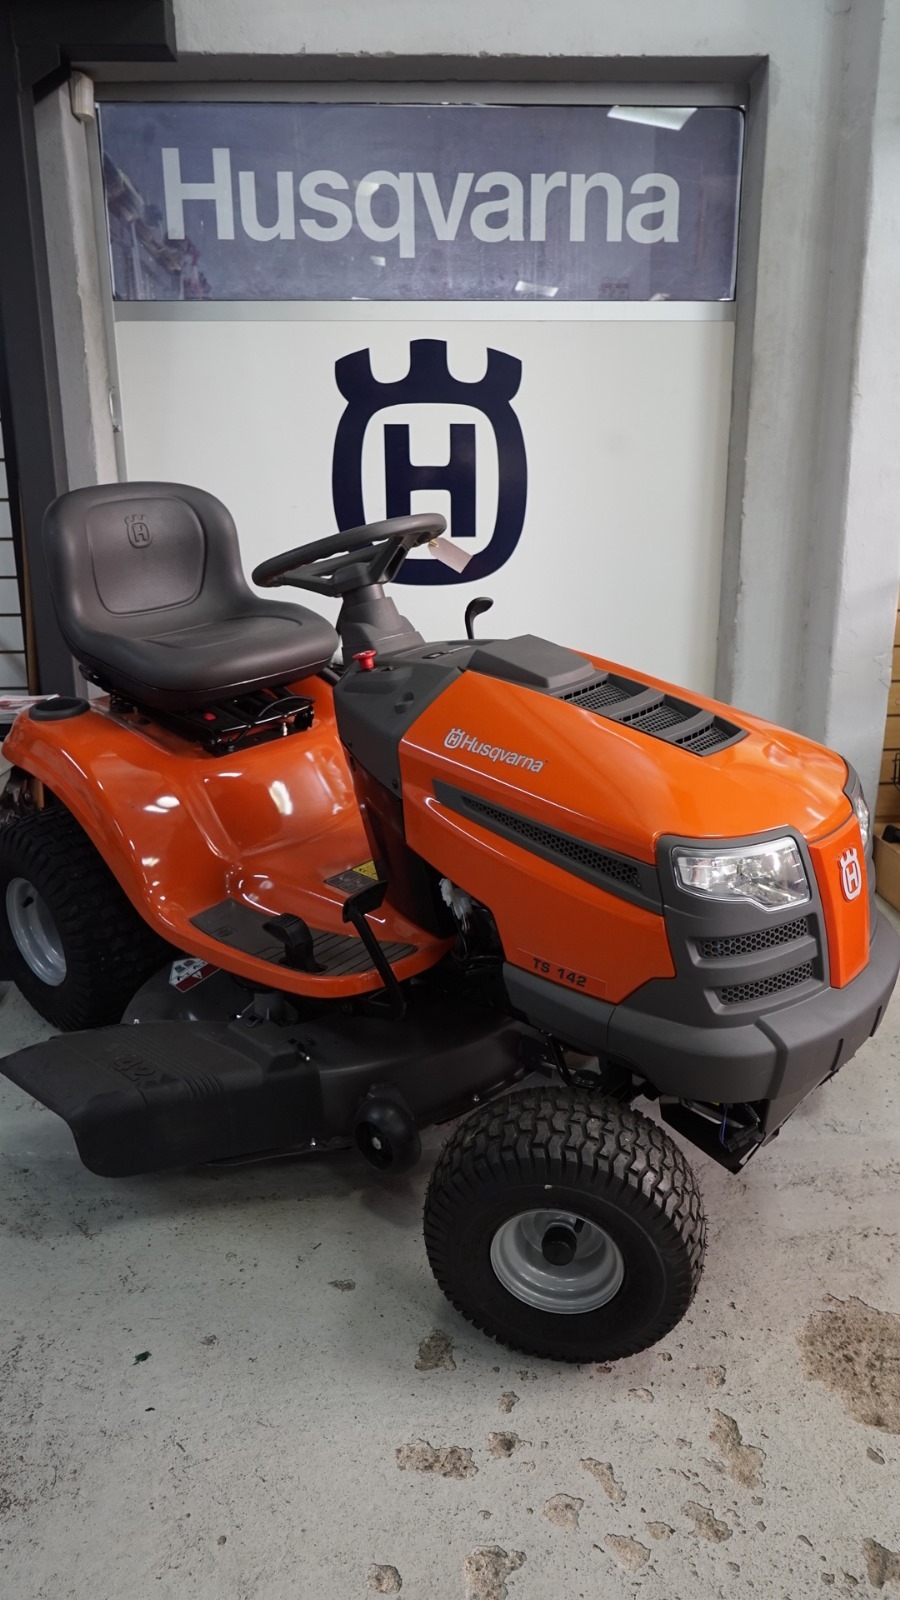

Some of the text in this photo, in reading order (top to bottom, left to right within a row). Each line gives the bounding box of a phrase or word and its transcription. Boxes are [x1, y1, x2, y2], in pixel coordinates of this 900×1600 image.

[162, 147, 680, 259] Husqvarna
[460, 733, 544, 772] Husqvarna
[533, 957, 587, 988] TS 142
